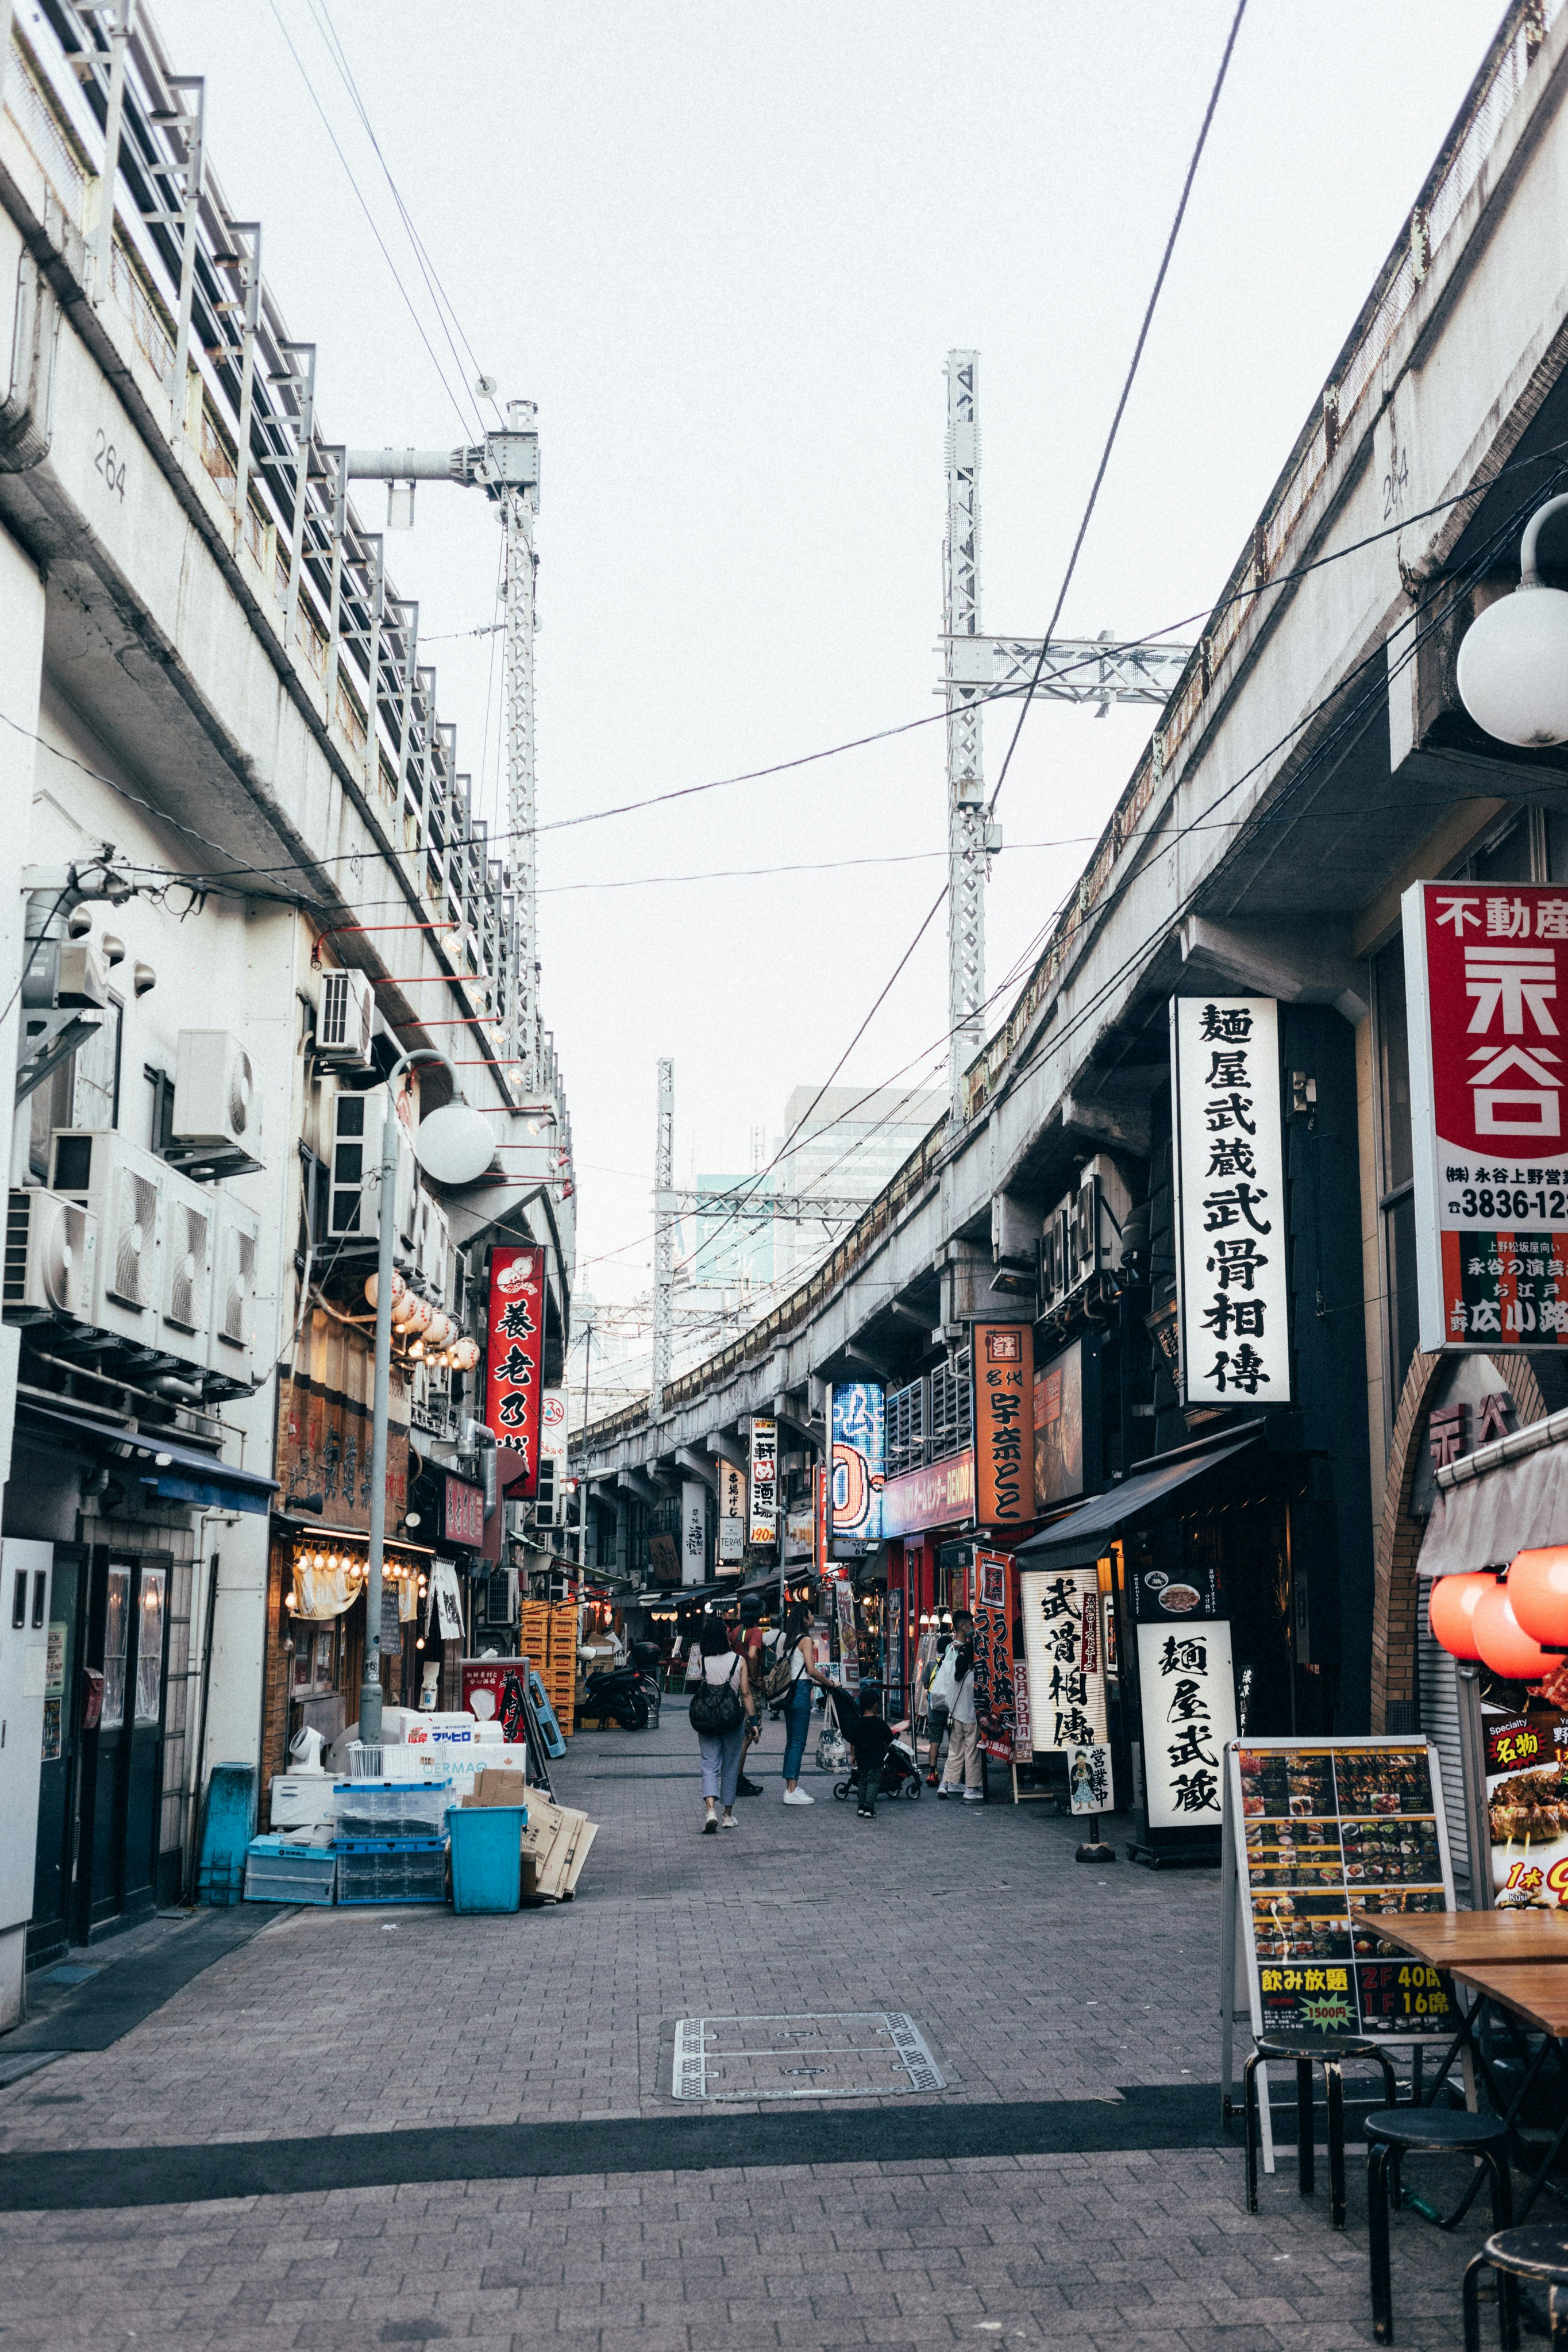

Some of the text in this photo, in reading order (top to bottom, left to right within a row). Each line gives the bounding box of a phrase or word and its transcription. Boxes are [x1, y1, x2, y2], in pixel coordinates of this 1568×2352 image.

[95, 427, 126, 504] 264
[1435, 896, 1568, 939] 不動産
[1462, 1189, 1568, 1219] 3836-12
[1488, 1241, 1561, 1254] 上野松坂屋向い
[1467, 1258, 1568, 1276] 永谷の演芸
[1493, 1283, 1560, 1298] お江戸
[1450, 1299, 1468, 1332] 上野
[1471, 1299, 1568, 1333] 広小路
[986, 1369, 1023, 1387] 名代
[991, 1392, 1022, 1519] 宇奈とと
[753, 1432, 776, 1518] 一軒め酒場
[728, 1472, 739, 1518] 串揚げじ
[721, 1538, 743, 1547] TERAS
[750, 1528, 776, 1542] 190円
[1041, 1577, 1095, 1747] 武骨相傳
[1015, 1666, 1030, 1738] 8月5日(月
[432, 1731, 471, 1742] マルヒロ
[1158, 1635, 1222, 1813] 麺屋武蔵
[1489, 1718, 1527, 1735] Specialty
[1496, 1732, 1538, 1765] 名物
[423, 1762, 487, 1774] CERMAQ
[1090, 1748, 1109, 1808] 営業中
[1505, 1861, 1544, 1891] 1本
[1509, 1893, 1528, 1902] Kusi
[1261, 1968, 1349, 1992] 飲み放題
[1362, 1967, 1392, 1989] 2F
[1309, 2007, 1347, 2018] 1500円
[1365, 1991, 1450, 2015] 1F 16席
